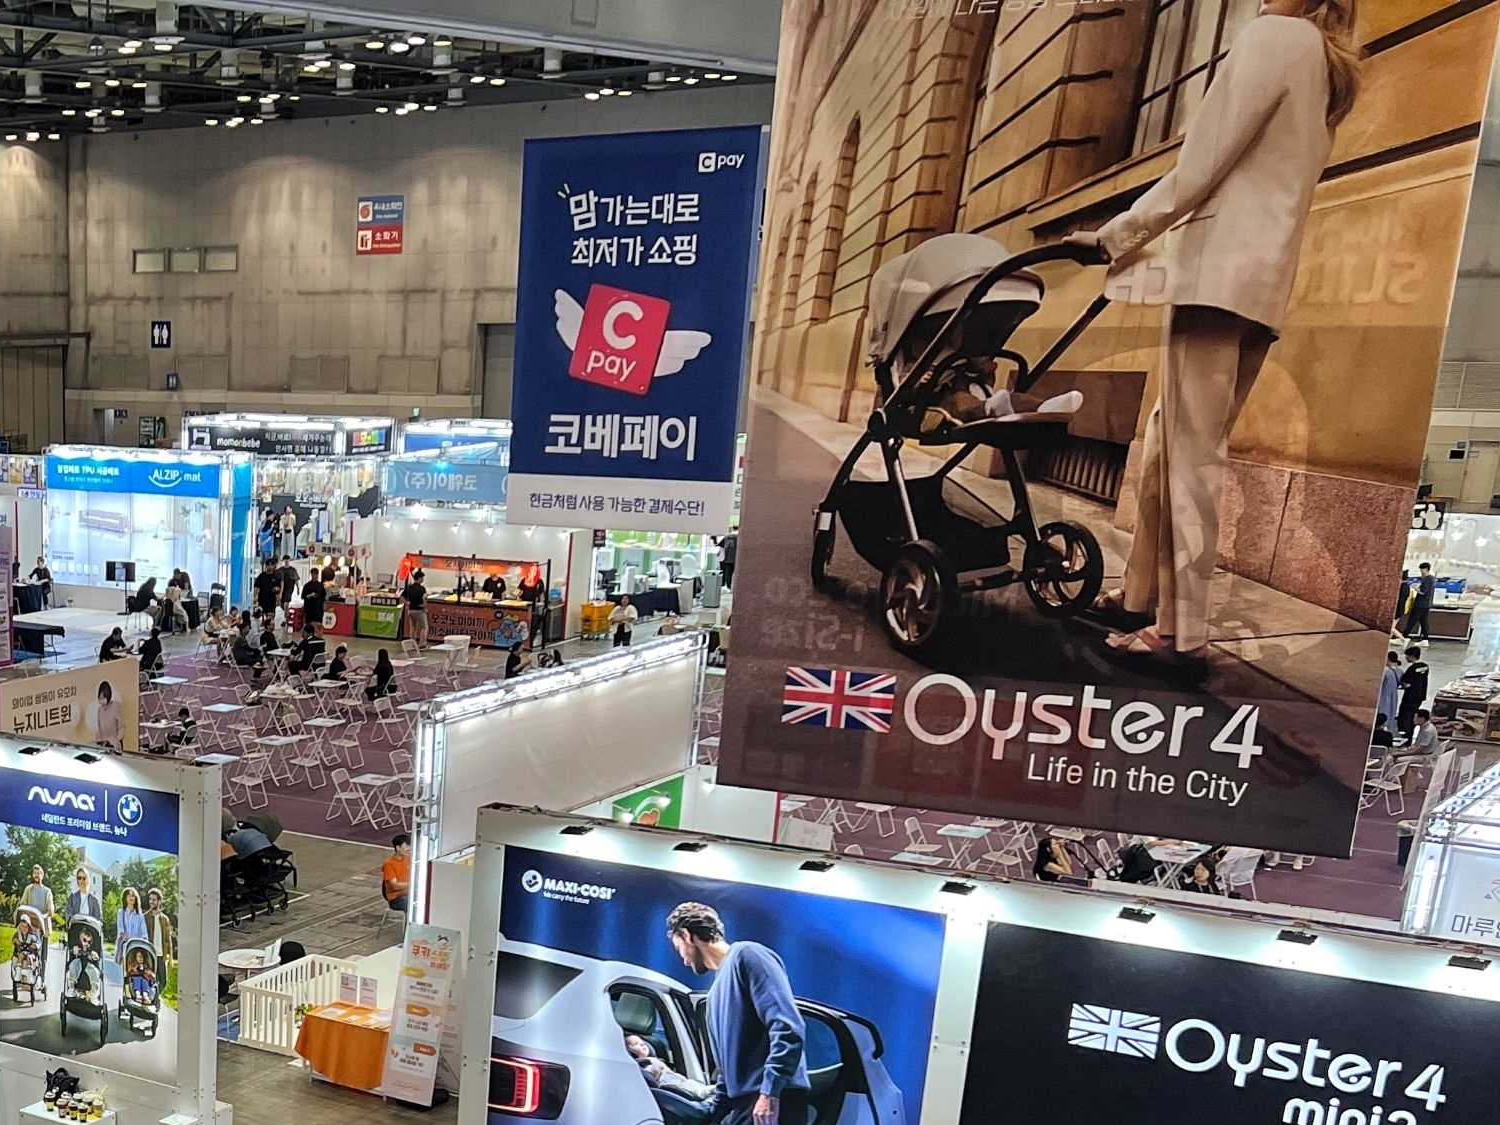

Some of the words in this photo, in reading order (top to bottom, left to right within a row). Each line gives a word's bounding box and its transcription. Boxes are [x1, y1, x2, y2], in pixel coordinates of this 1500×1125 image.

[717, 153, 745, 171] pay
[375, 231, 399, 240] 소화기
[571, 236, 644, 267] 최저가
[647, 233, 698, 266] 쇼핑
[602, 299, 644, 350] C
[587, 349, 636, 383] pay
[544, 413, 698, 461] 코베페이
[152, 468, 180, 482] ALZIP
[184, 472, 202, 482] mat
[607, 495, 647, 514] 가능한
[648, 497, 705, 516] 결제수단!
[11, 695, 34, 710] 와이업
[56, 685, 78, 699] 유모차
[13, 704, 72, 734] 뉴지니트윈
[903, 673, 1204, 760] Oyster
[1209, 704, 1264, 769] 4
[1027, 752, 1083, 786] Life
[1091, 761, 1117, 788] in
[1125, 765, 1175, 795] the
[1184, 768, 1249, 807] City
[27, 785, 95, 812] nuna
[66, 817, 92, 830] 프리미엄
[1165, 1017, 1401, 1098] Oyster
[1403, 1063, 1448, 1112] 4
